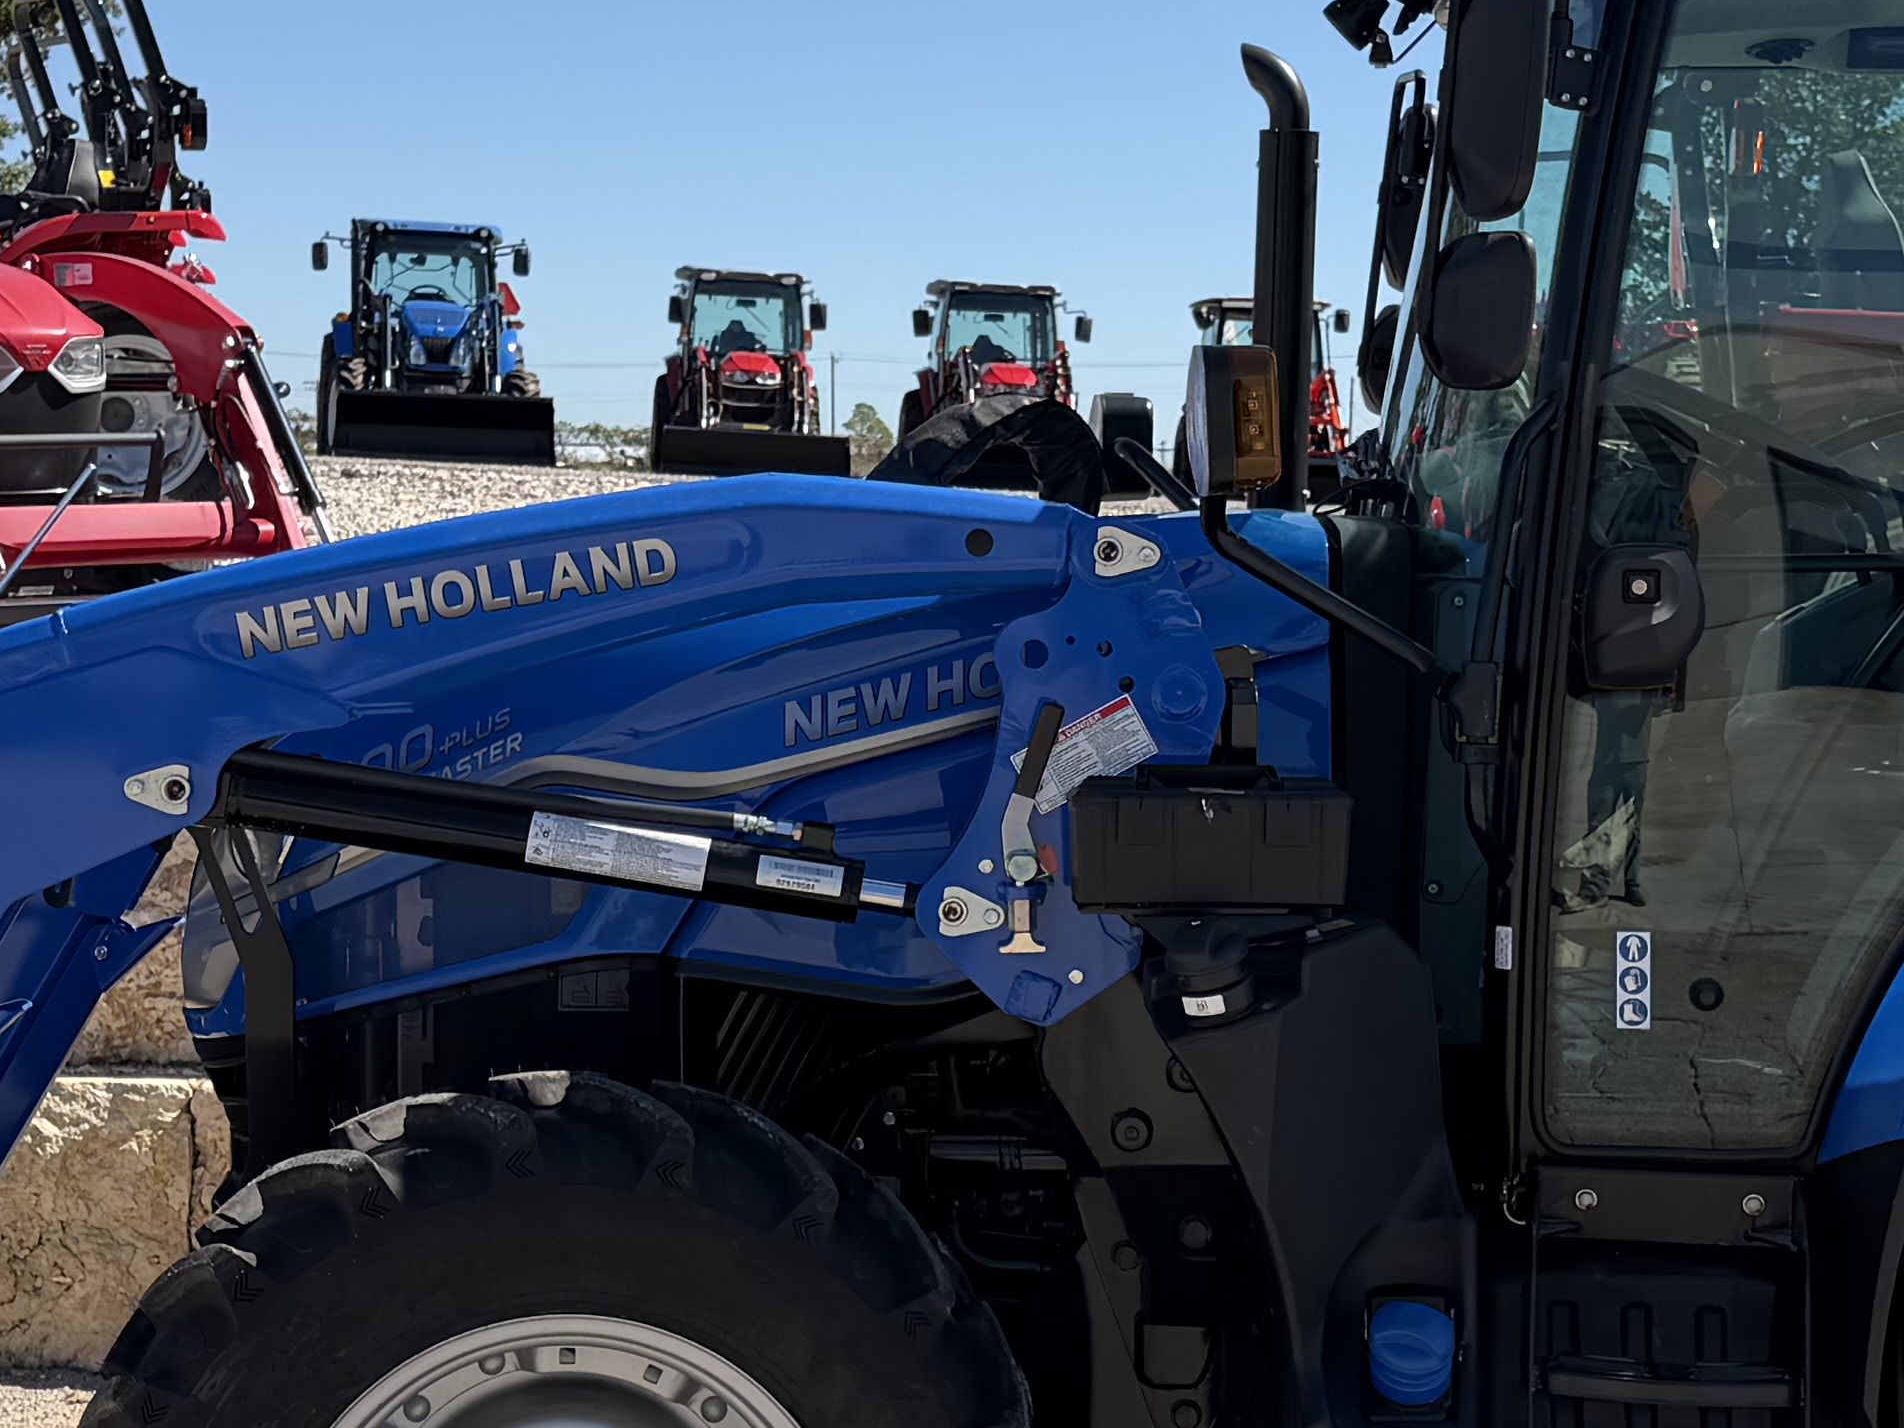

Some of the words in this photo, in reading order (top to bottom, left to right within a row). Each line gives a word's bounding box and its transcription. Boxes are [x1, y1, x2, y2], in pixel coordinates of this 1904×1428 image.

[235, 586, 371, 659] NEW
[382, 537, 678, 629] HOLLAND
[783, 672, 913, 748] NEW
[431, 731, 523, 780] ASTER
